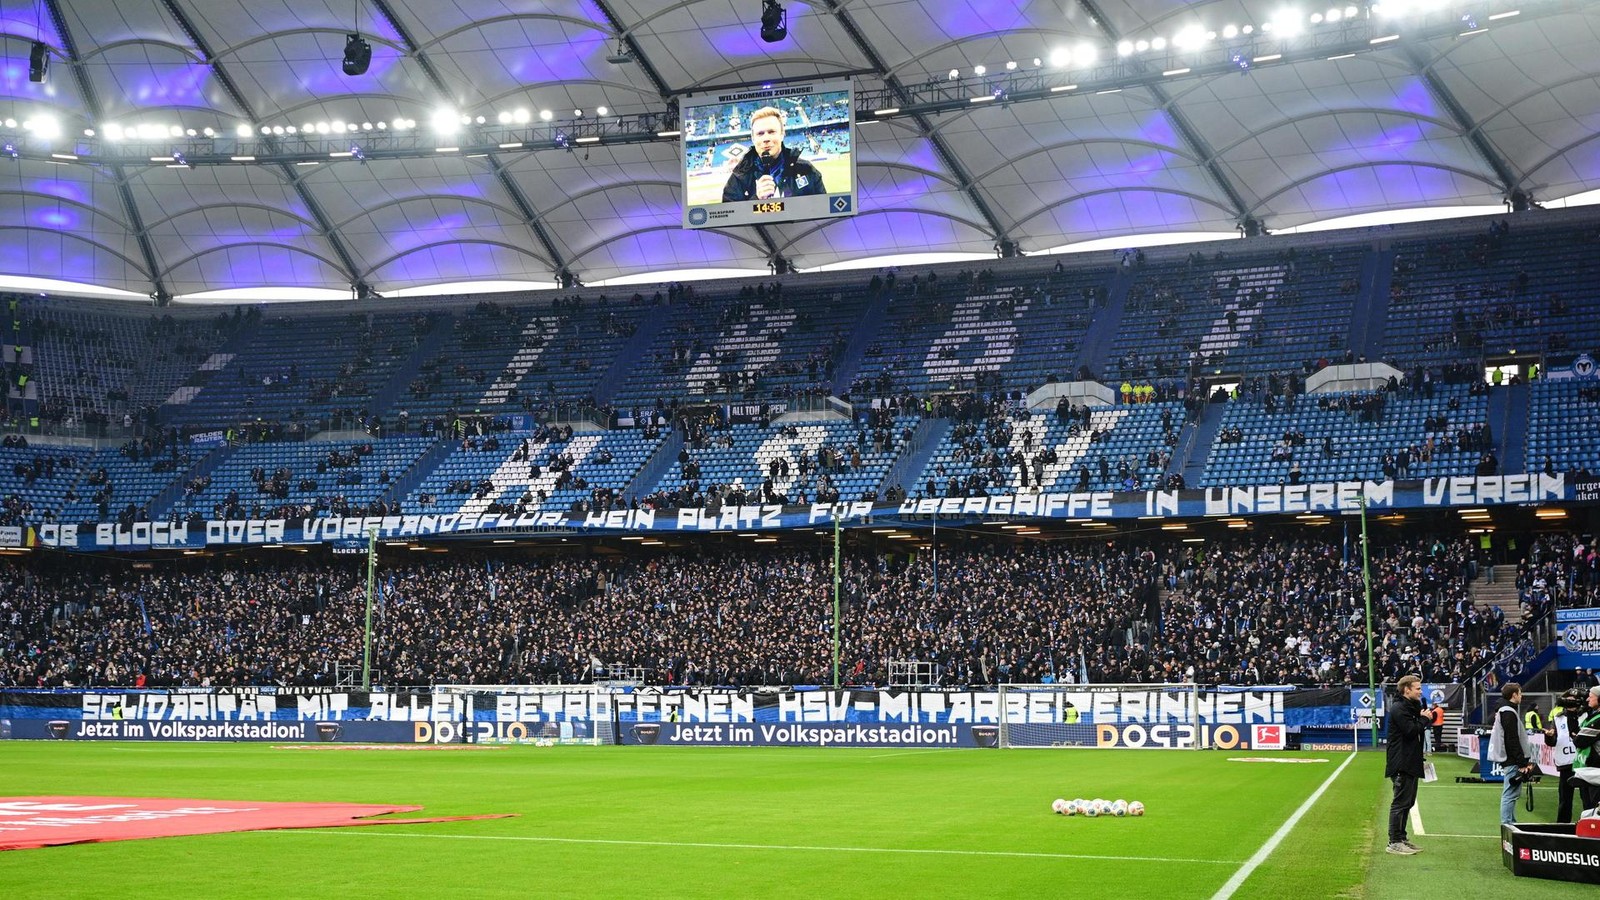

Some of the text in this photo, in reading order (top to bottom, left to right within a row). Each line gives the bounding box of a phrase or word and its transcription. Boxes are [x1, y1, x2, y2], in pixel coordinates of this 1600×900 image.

[719, 86, 813, 102] WILLKOMMEN ZUHAUSE!
[753, 202, 781, 213] 14:36
[41, 525, 78, 546] OB
[206, 519, 286, 543] ODER
[677, 504, 783, 529] PLATZ
[809, 502, 873, 523] FÜR
[898, 492, 1113, 516] ÜBERGRIFFE
[1146, 490, 1178, 515] IN
[1205, 480, 1394, 514] UNSEREM
[1423, 473, 1565, 504] VEREIN
[83, 693, 277, 720] SOLIDARITÄT
[297, 693, 348, 720] MIT
[366, 693, 474, 721] ALLEN
[497, 693, 754, 722] BETROFFENEN
[77, 722, 305, 740] Jetzt im Volksparkstadion!
[670, 724, 957, 745] Jetzt im Volksparkstadion!
[1312, 743, 1353, 751] buXtrade
